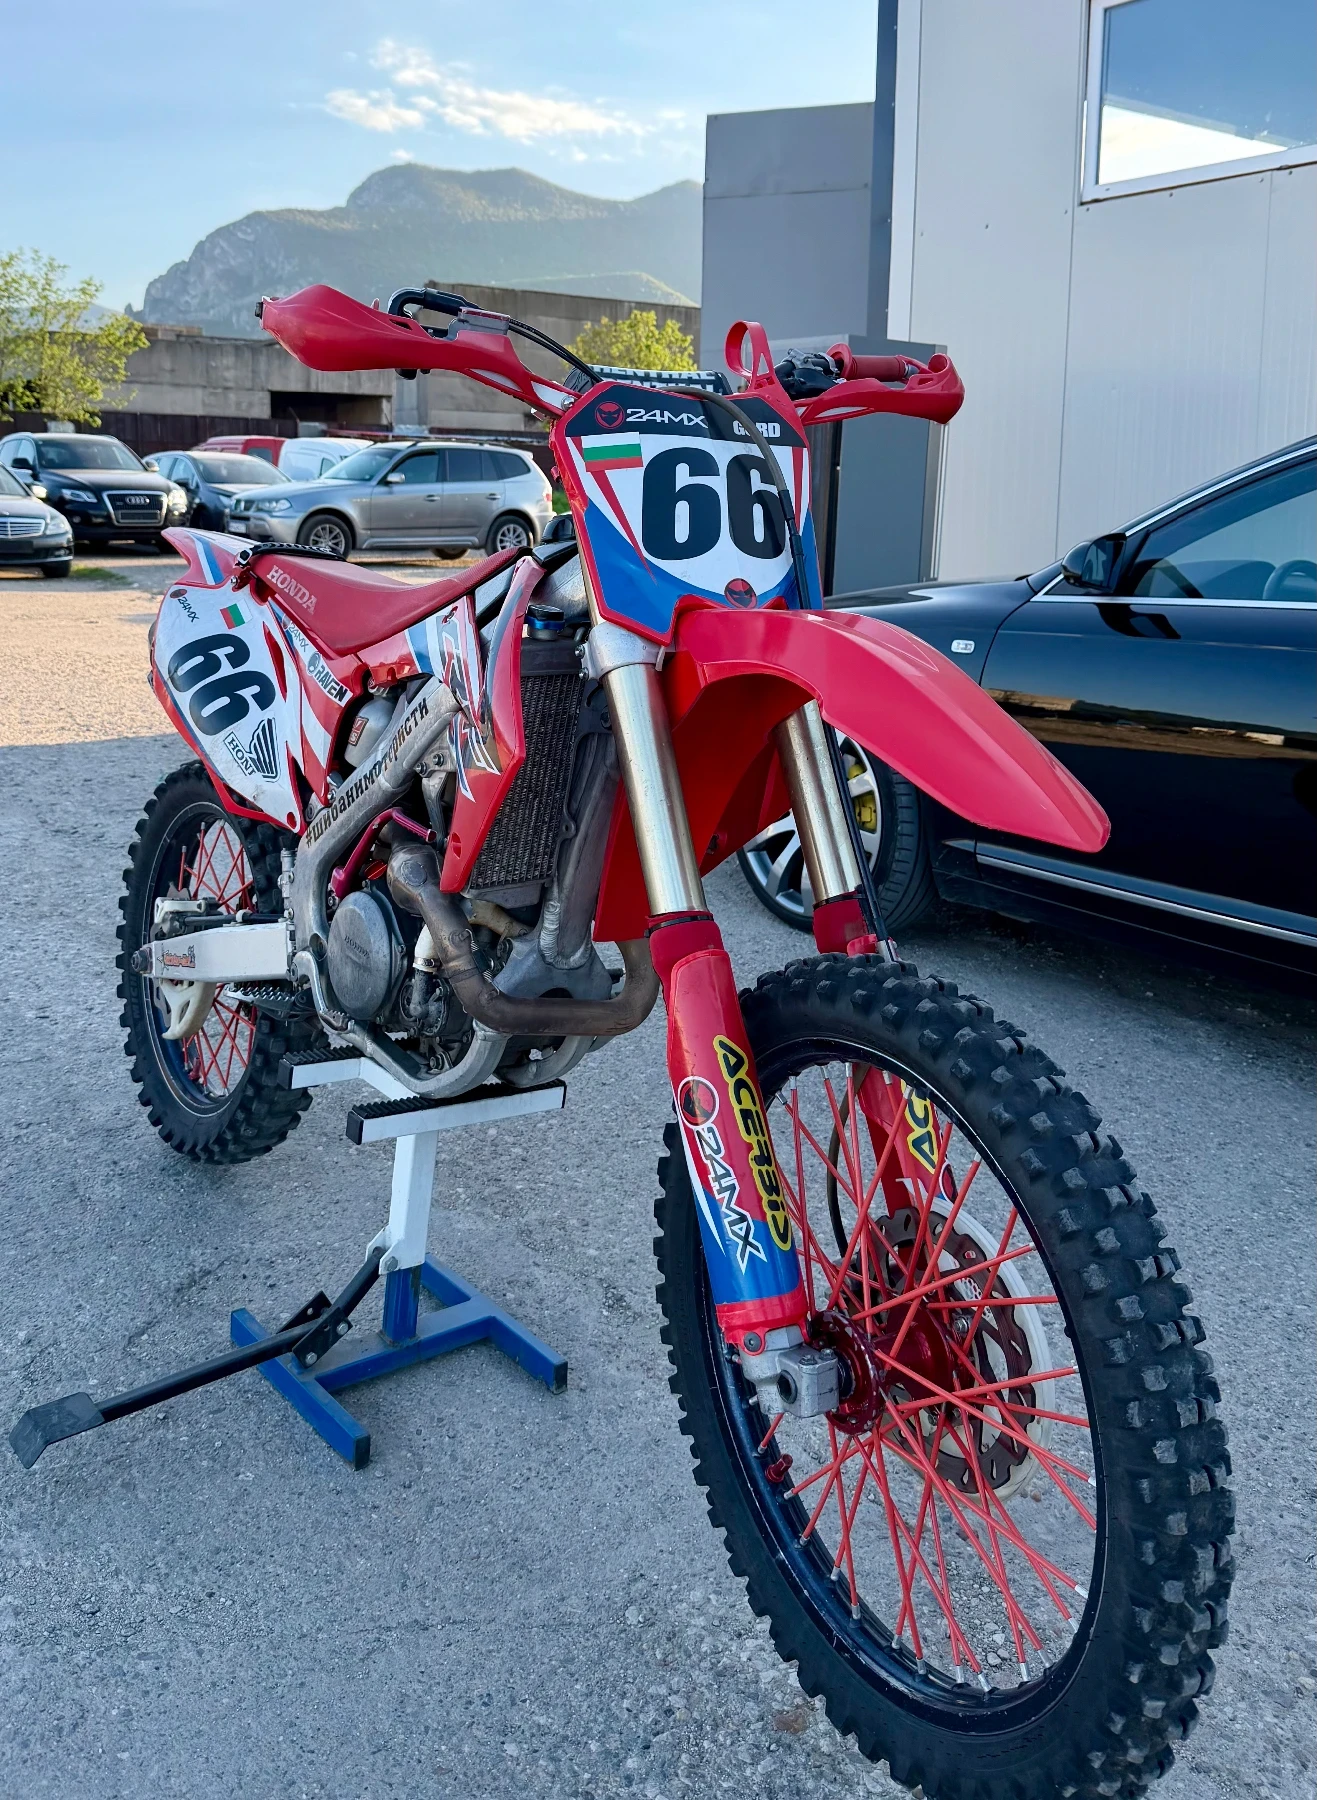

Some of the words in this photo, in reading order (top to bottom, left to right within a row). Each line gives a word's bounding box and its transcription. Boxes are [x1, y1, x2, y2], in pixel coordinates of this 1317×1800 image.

[625, 408, 709, 429] 24MX
[733, 420, 780, 437] GRD
[641, 447, 786, 561] 66
[266, 565, 317, 615] HONDA
[177, 597, 199, 622] 24MX
[288, 622, 309, 652] 24MX
[167, 634, 276, 736] 66
[315, 665, 347, 703] RAVEN
[696, 1127, 764, 1270] 24MX
